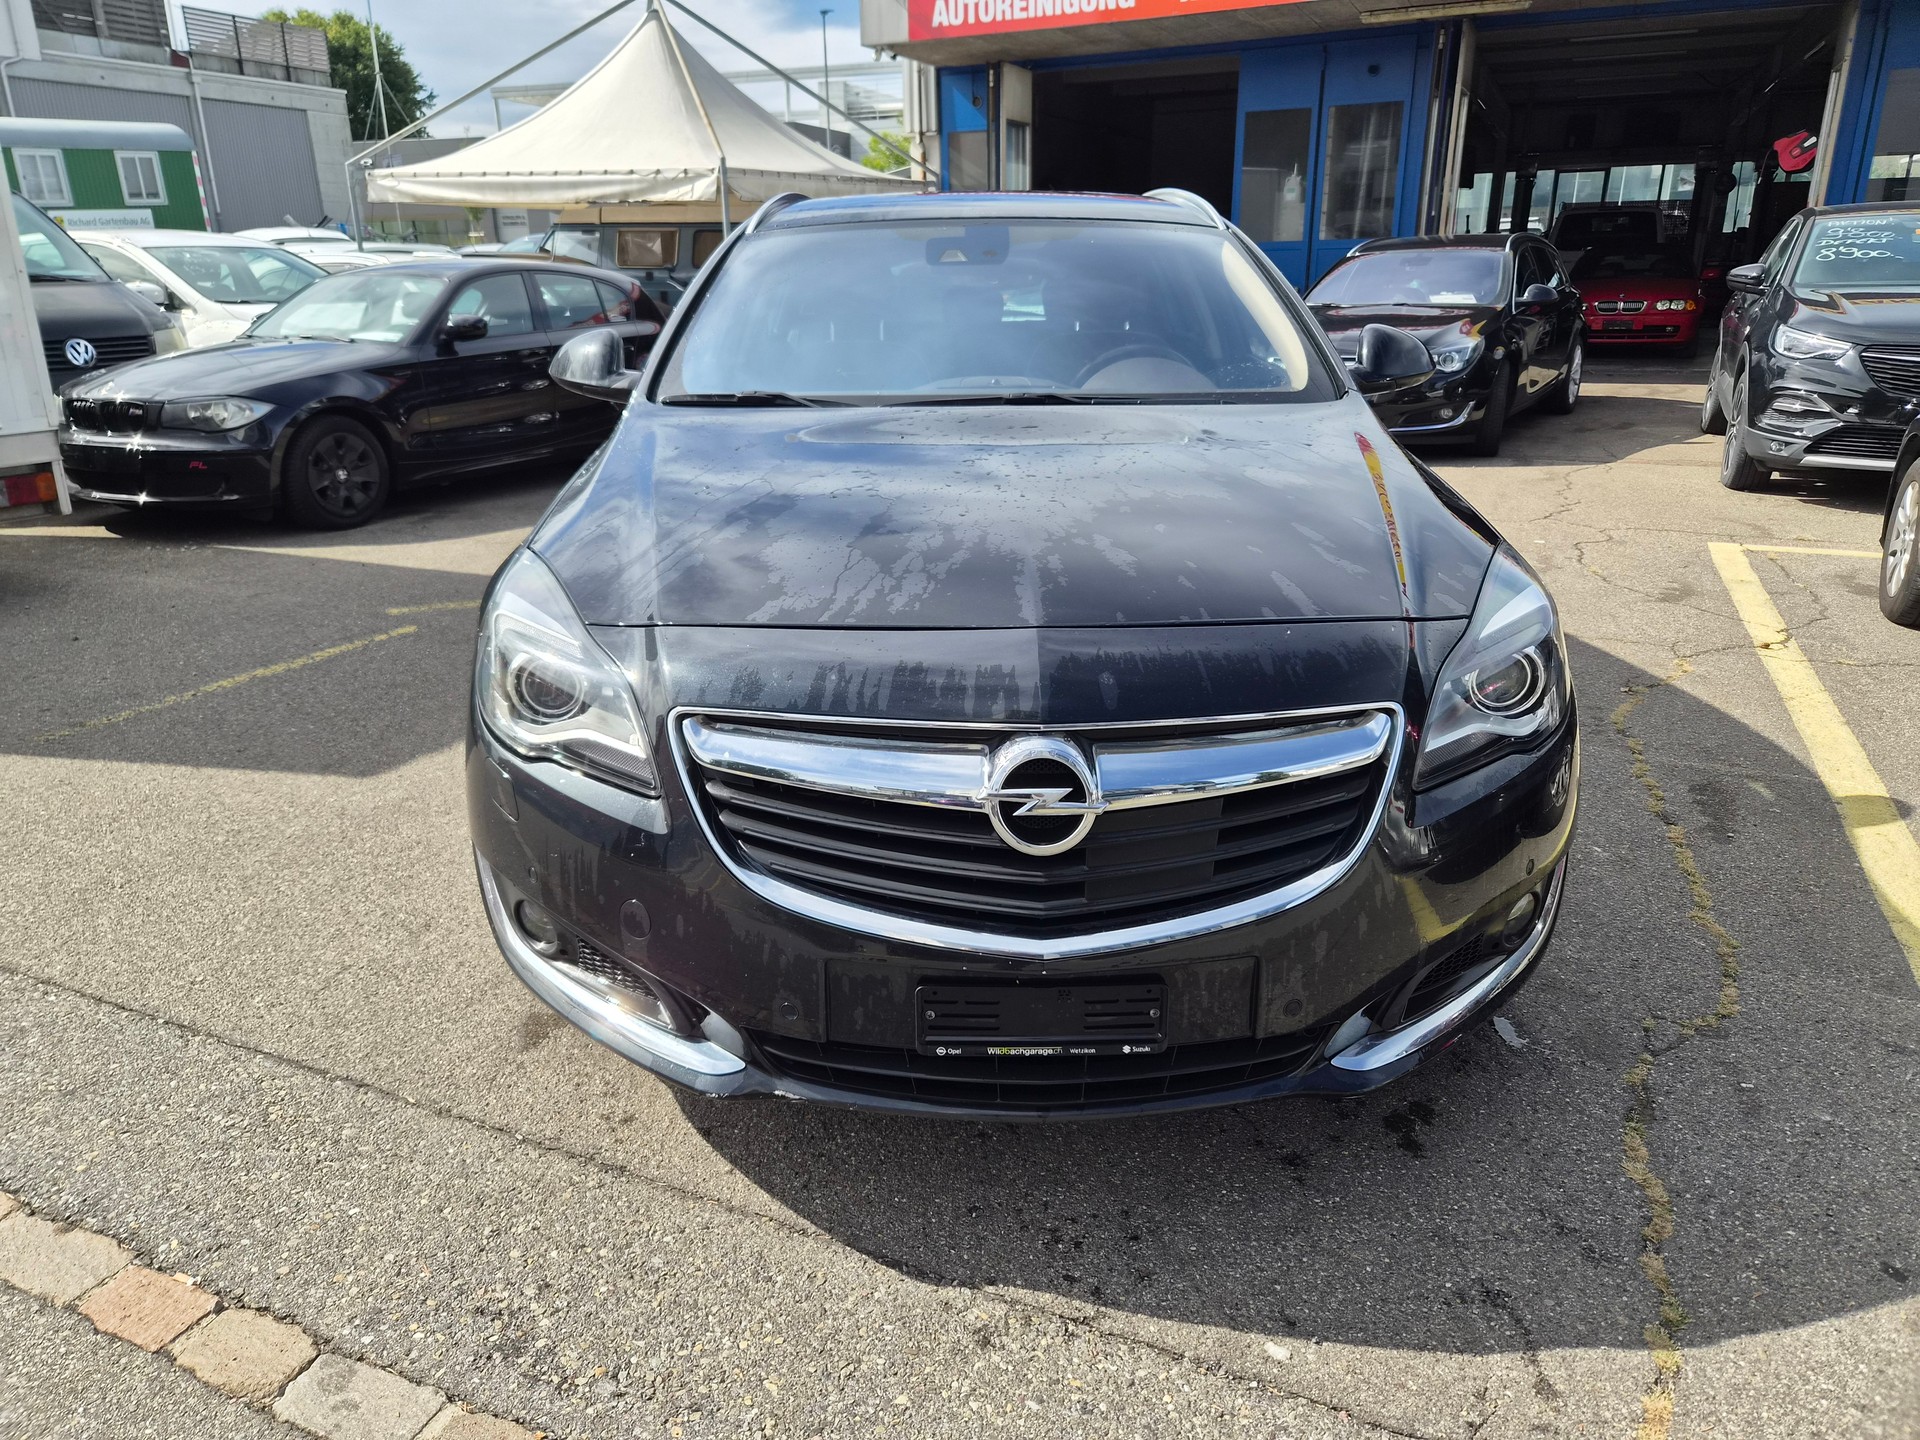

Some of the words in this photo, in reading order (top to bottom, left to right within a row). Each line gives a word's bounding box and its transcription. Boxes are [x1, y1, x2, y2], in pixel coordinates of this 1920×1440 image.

[65, 338, 97, 367] VW
[987, 1047, 1063, 1056] Wildbachgarage.ch
[1069, 1047, 1096, 1055] Wetzikon
[1132, 1045, 1151, 1053] Suzuki
